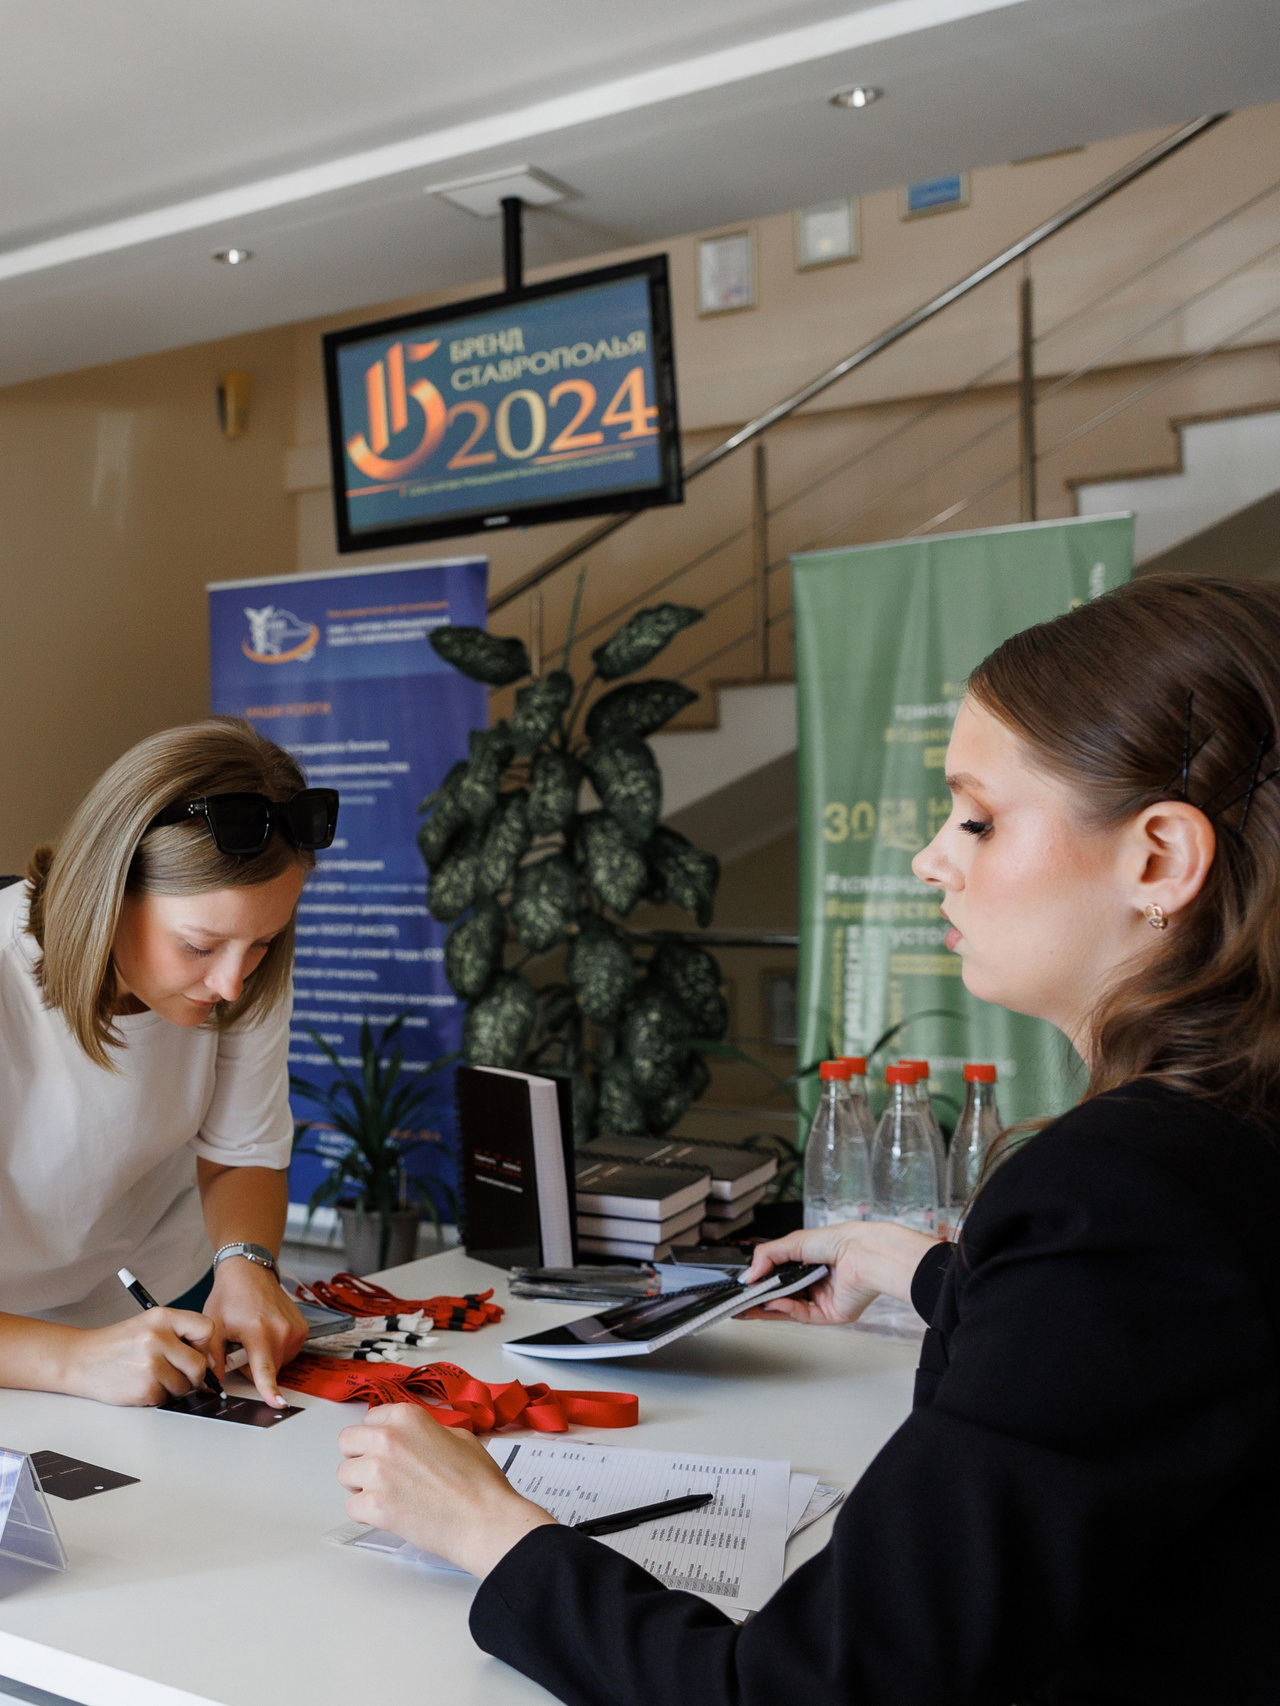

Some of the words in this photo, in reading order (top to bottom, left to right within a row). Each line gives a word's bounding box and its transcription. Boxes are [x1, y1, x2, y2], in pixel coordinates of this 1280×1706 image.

[449, 326, 525, 363] БРЕНД
[450, 330, 647, 392] СТАВРОПОЛЬЯ
[446, 366, 661, 471] 2024
